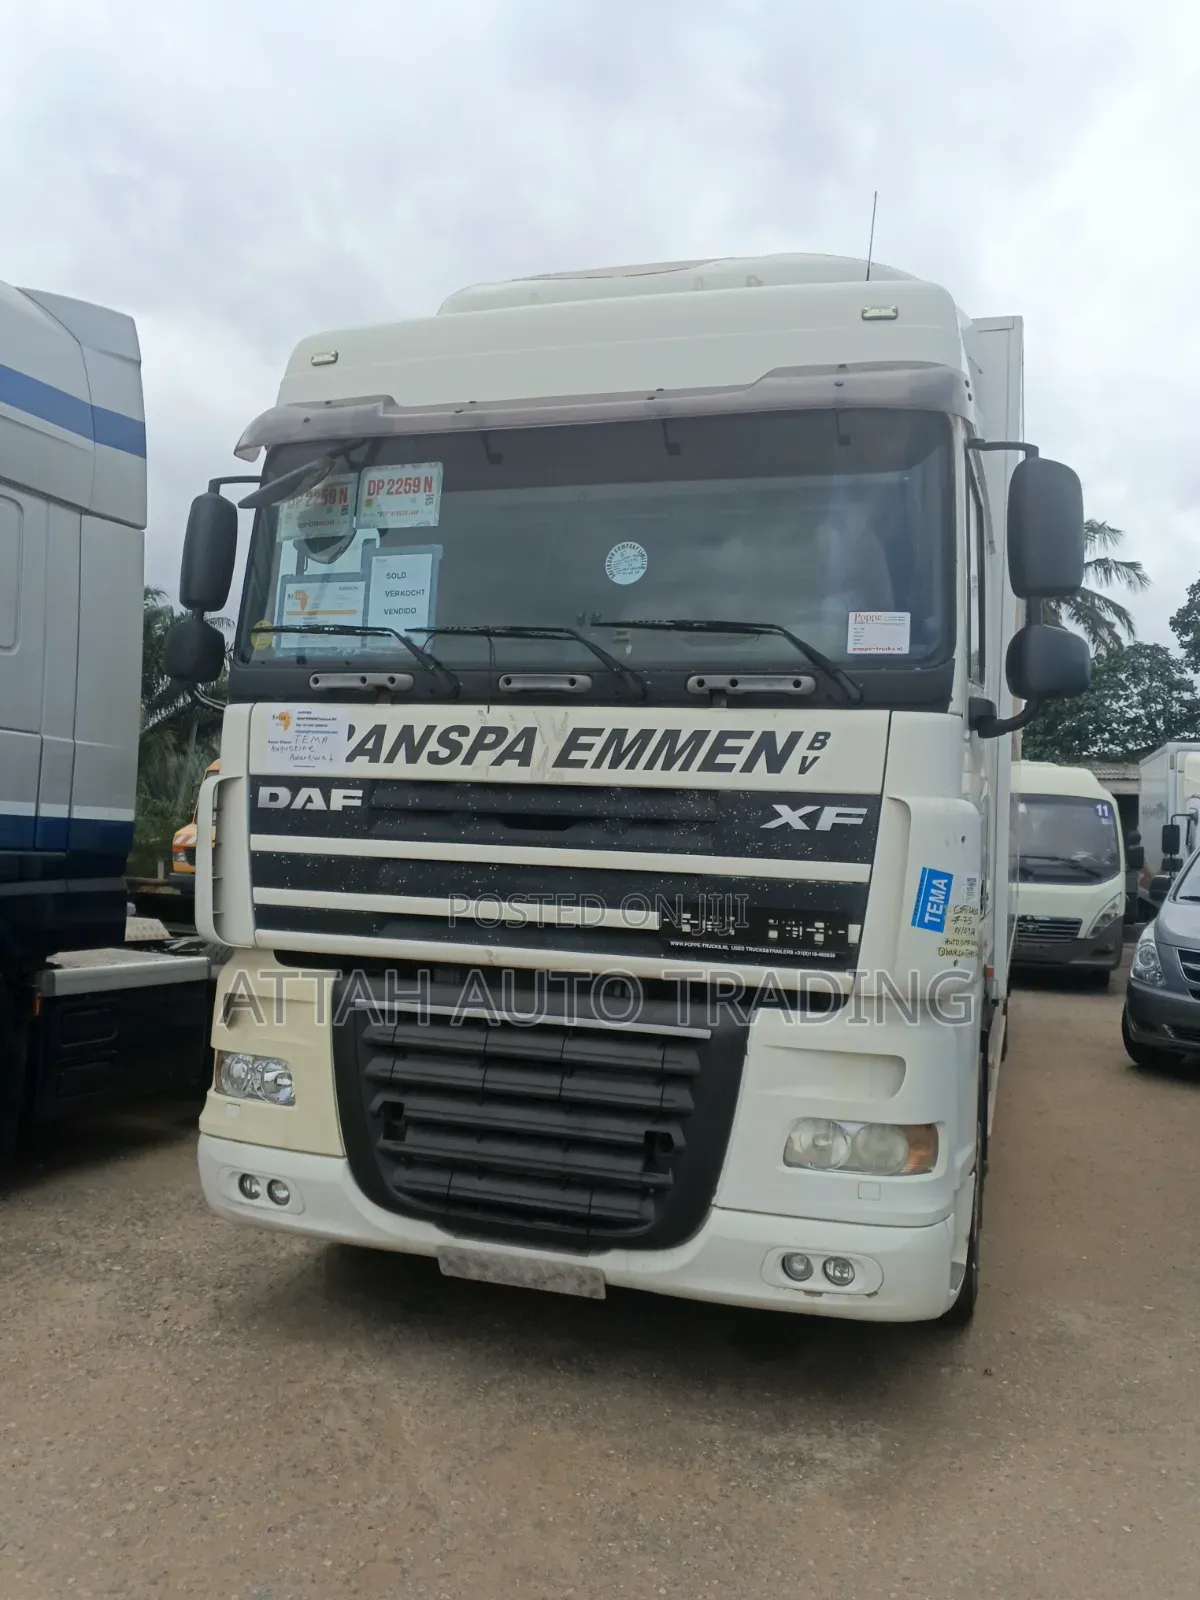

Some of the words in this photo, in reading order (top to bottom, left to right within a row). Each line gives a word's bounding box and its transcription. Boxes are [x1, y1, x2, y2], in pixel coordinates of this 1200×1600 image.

[367, 479, 385, 497] DP
[387, 477, 421, 496] 2259
[424, 475, 434, 494] N
[339, 487, 348, 505] N
[386, 571, 407, 580] SOLD
[385, 588, 426, 598] VERKOCHT
[383, 607, 417, 616] VENDIDO
[295, 735, 329, 744] TEMA
[551, 727, 804, 775] EMMEN
[257, 786, 364, 811] DAF
[760, 804, 868, 831] XF
[1096, 804, 1109, 817] 11
[924, 879, 949, 924] TEMA
